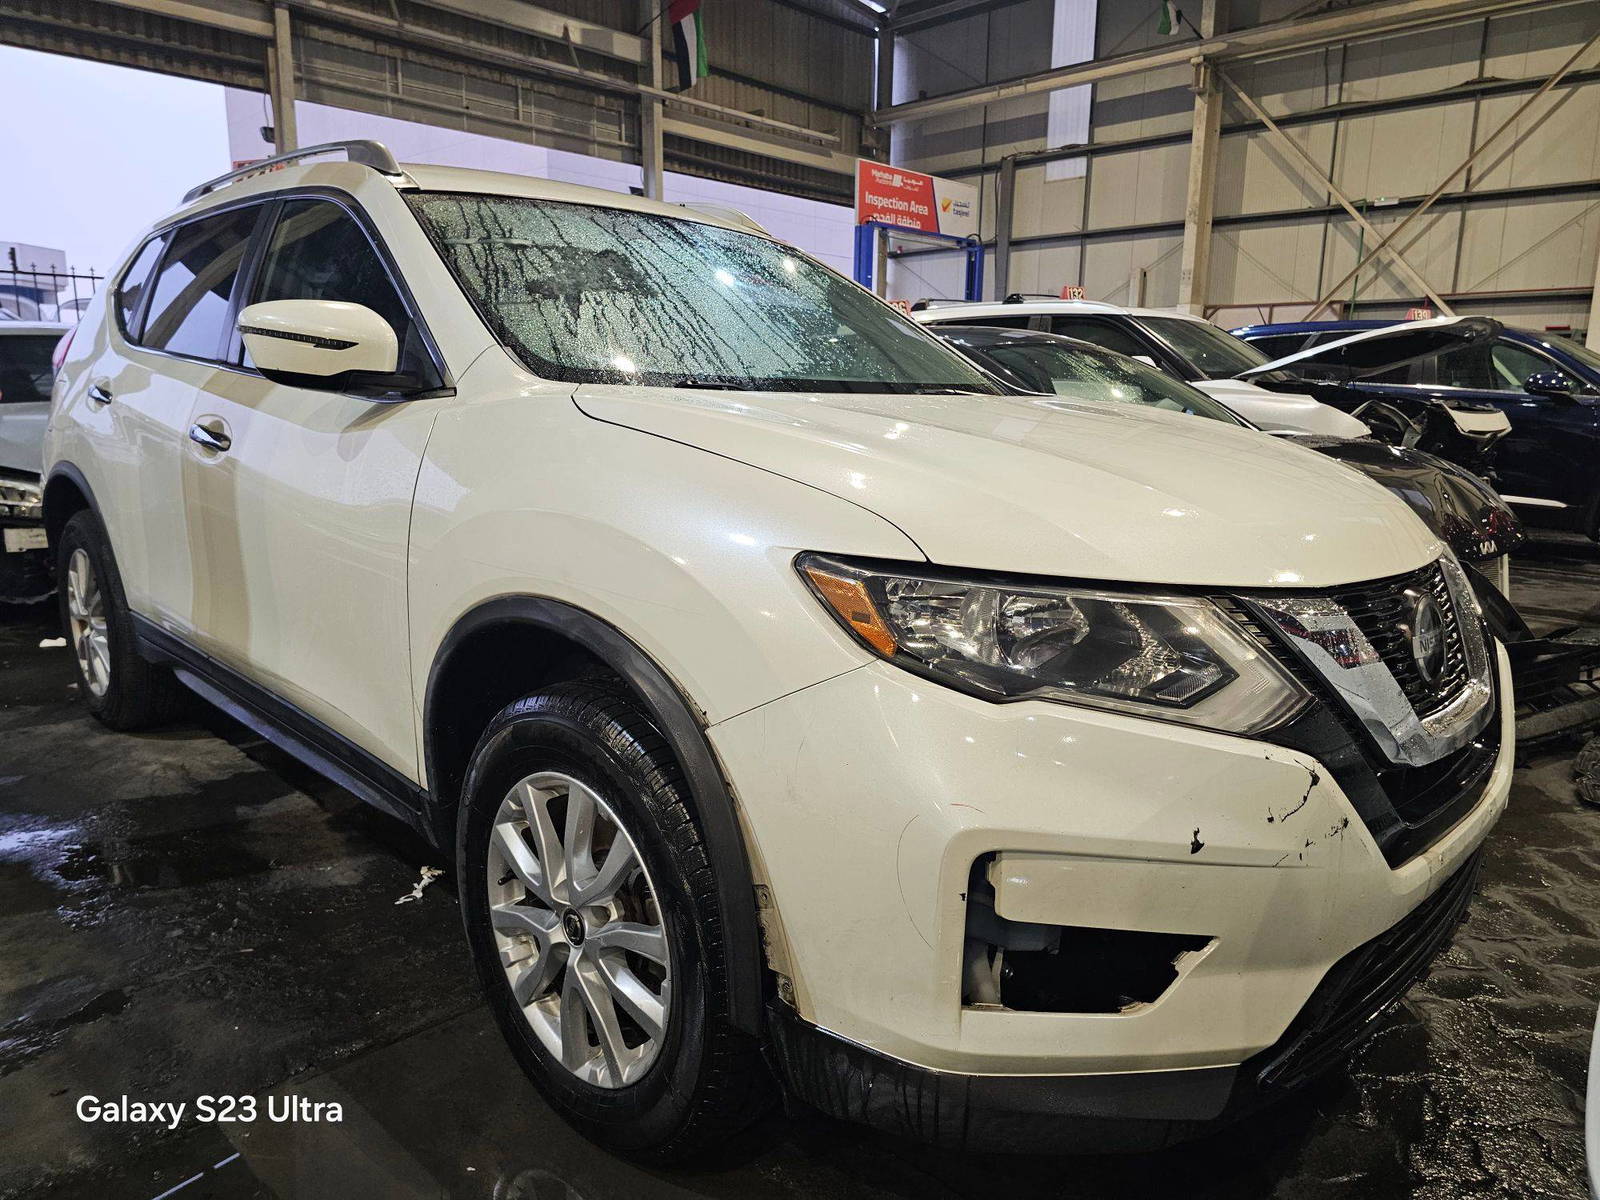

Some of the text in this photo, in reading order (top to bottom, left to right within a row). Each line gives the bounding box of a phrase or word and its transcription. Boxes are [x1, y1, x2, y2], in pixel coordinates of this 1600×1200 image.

[865, 191, 928, 216] Inspection Area
[1070, 287, 1083, 300] 132
